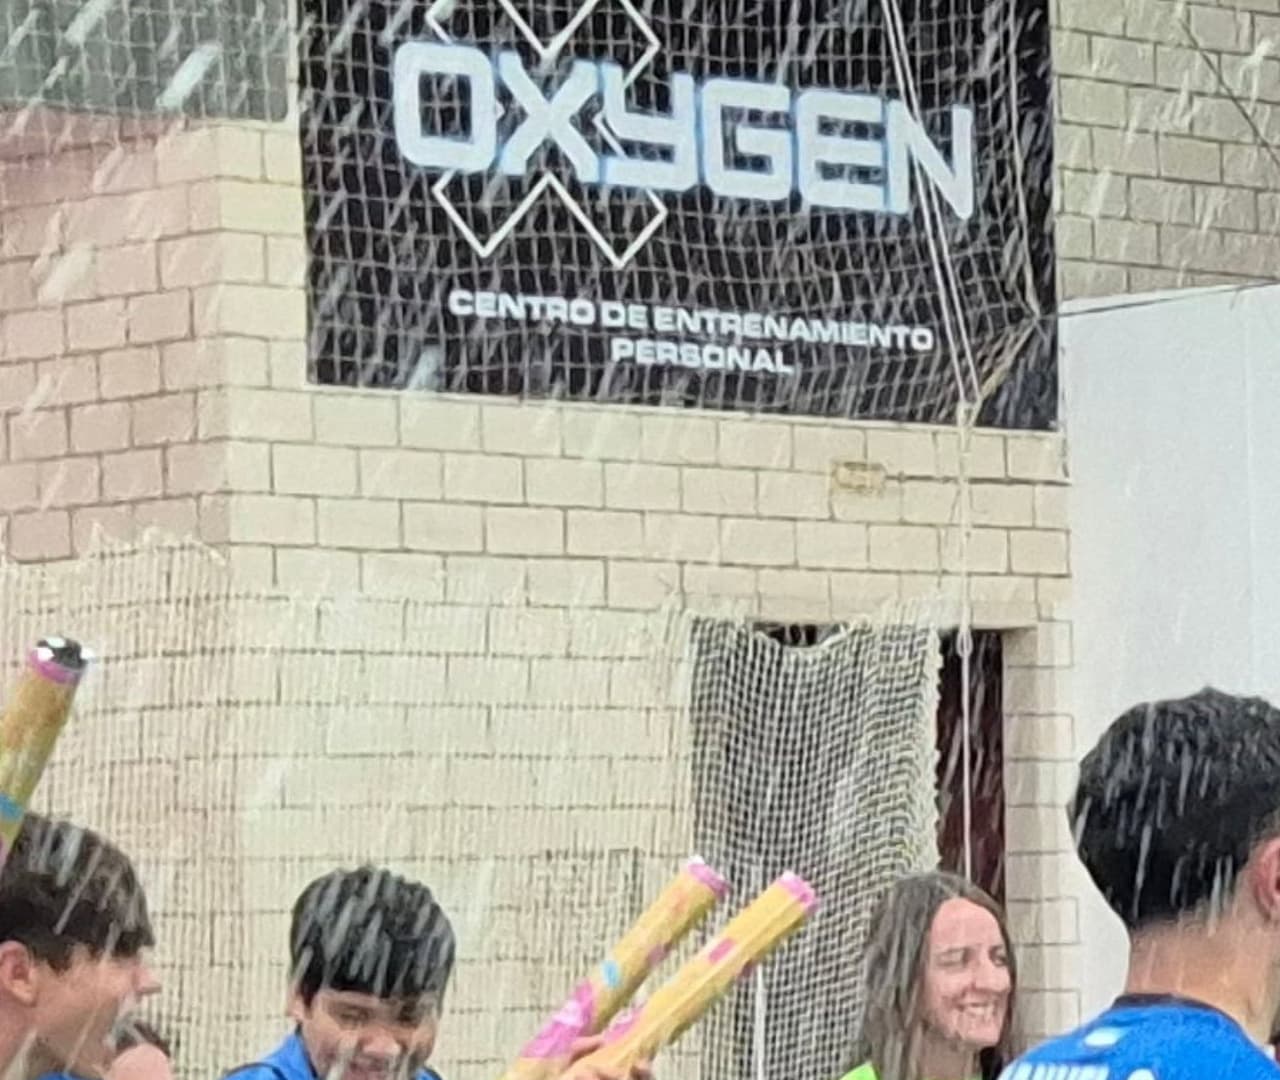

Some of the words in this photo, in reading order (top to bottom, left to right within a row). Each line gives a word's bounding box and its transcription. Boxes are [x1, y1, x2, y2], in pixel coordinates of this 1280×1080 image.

[394, 40, 974, 221] OXYGEN
[449, 288, 595, 328] CENTRO
[601, 300, 650, 331] DE
[653, 307, 935, 353] ENTRENAMIENTO
[610, 336, 796, 376] PERSONAL
